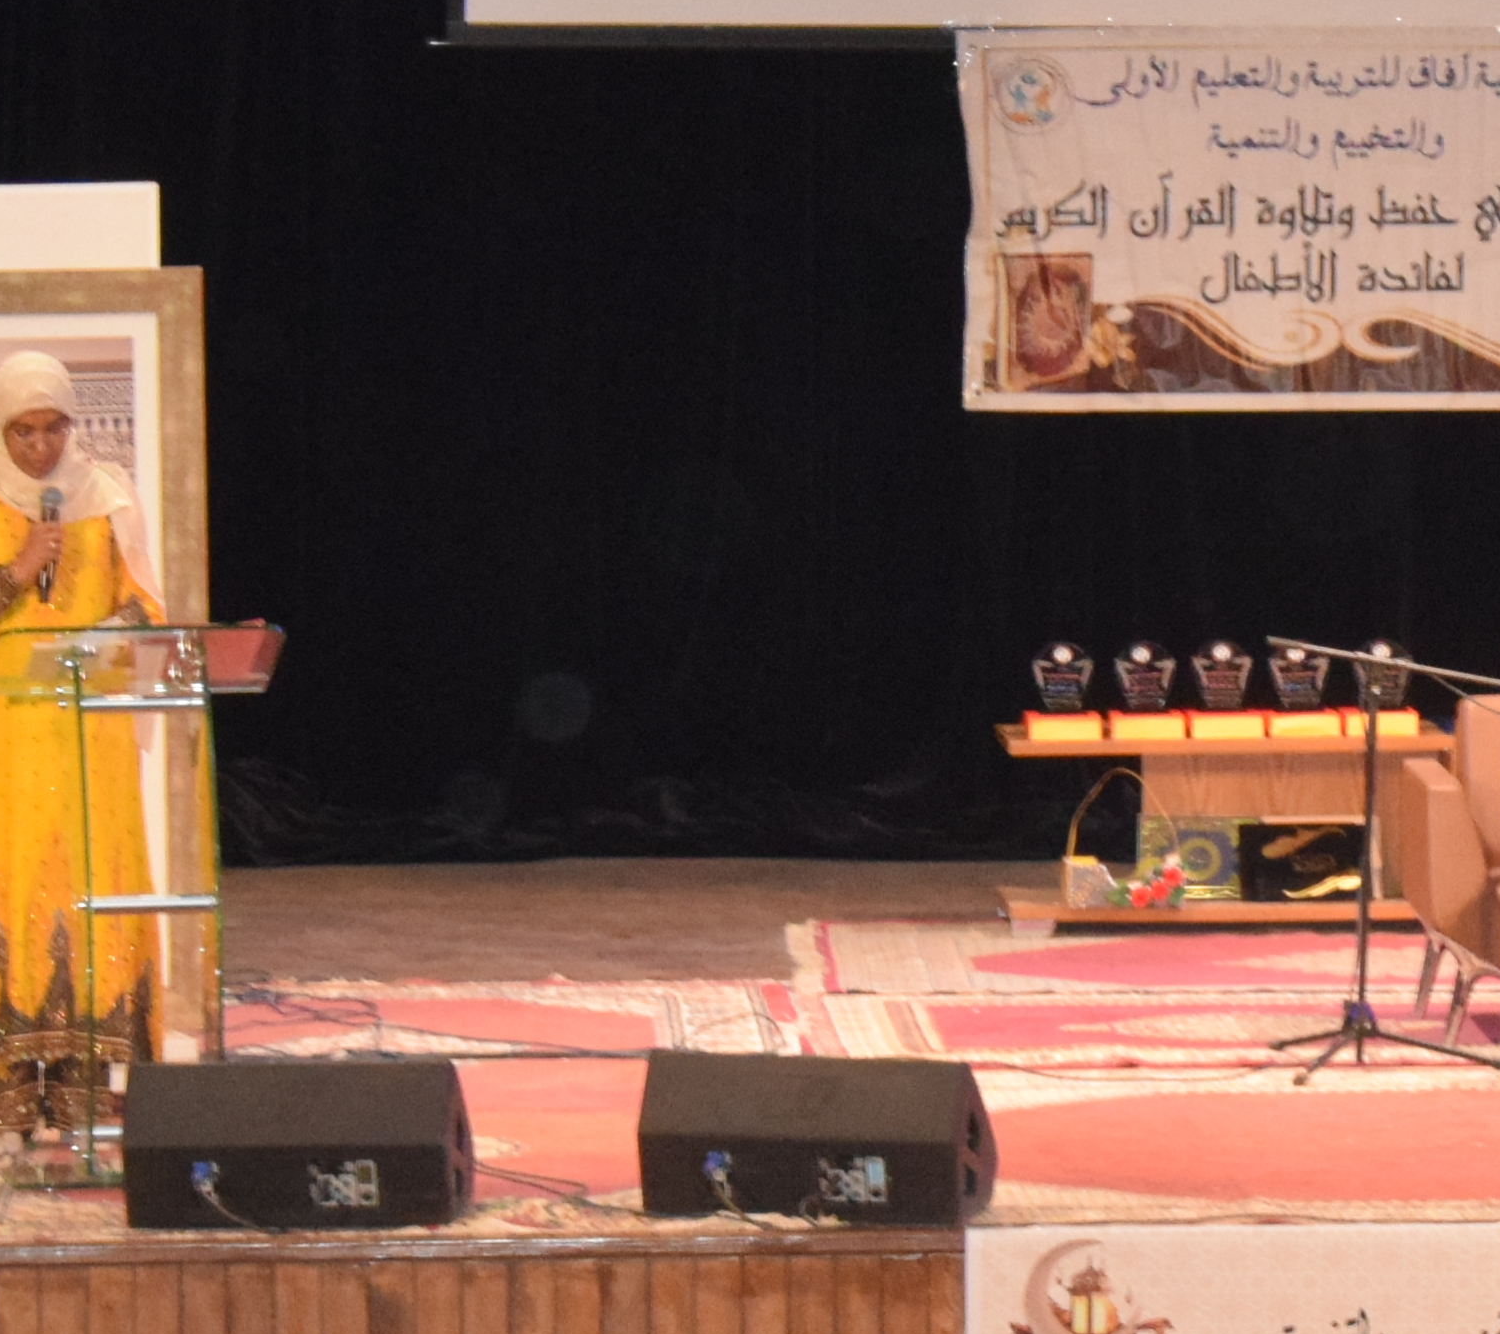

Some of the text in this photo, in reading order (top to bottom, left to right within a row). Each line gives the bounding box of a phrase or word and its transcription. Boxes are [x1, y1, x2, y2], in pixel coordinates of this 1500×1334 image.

[1192, 54, 1300, 108] والتعليم
[1305, 55, 1401, 97] للتربية
[1206, 116, 1445, 170] والتخييم والتنمية
[995, 178, 1109, 242] الكريم
[1257, 183, 1355, 240] وتلاوة
[1368, 183, 1460, 233] حفظ
[1200, 240, 1337, 304] الأطفال
